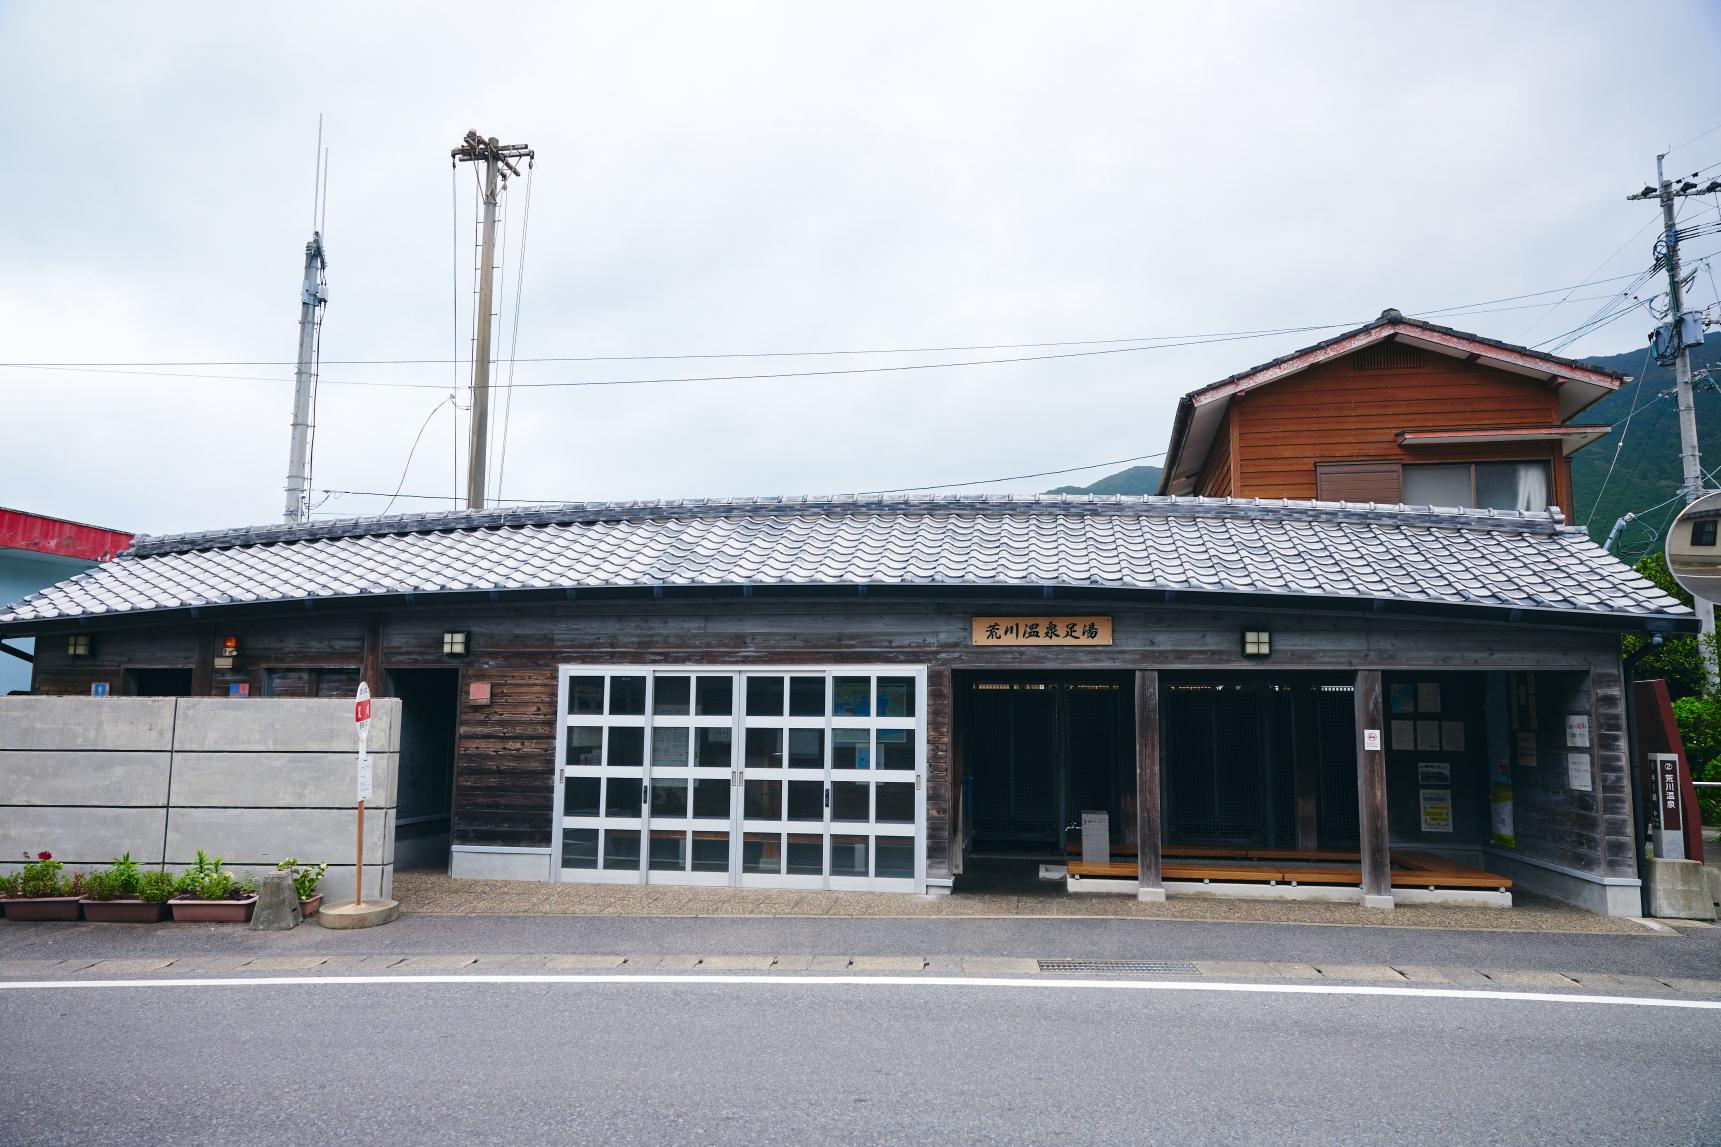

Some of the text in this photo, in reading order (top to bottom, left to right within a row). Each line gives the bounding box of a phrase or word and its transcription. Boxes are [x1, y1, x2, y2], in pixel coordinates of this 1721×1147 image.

[985, 621, 1099, 640] 荒川温泉足湯
